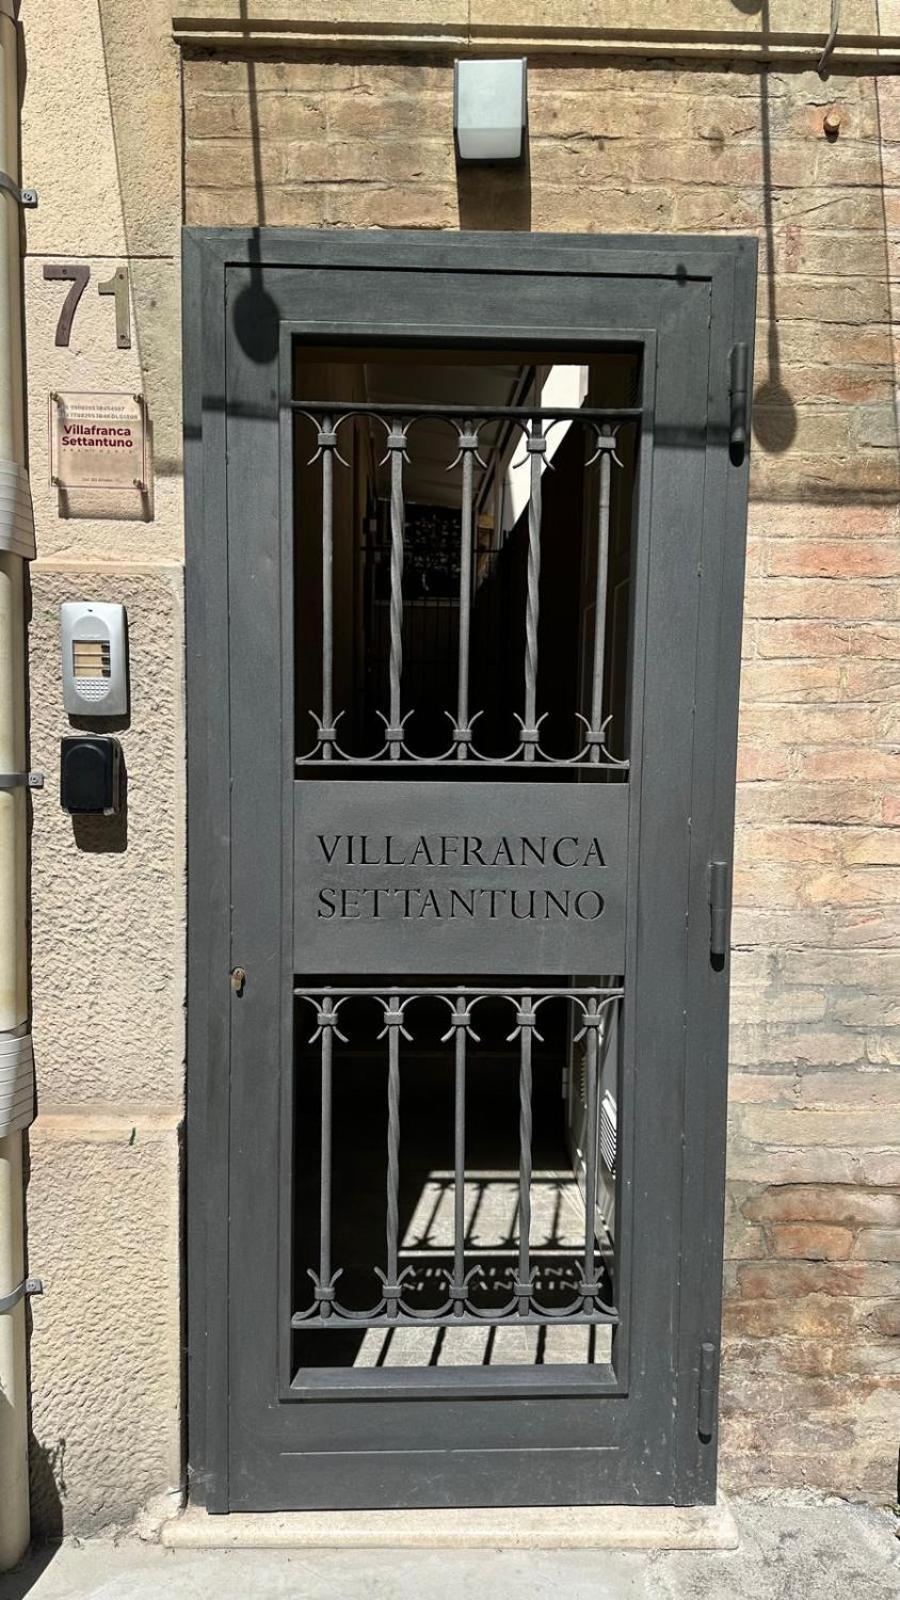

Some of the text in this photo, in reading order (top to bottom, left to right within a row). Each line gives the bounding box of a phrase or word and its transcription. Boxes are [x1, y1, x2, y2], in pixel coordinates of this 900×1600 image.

[43, 265, 131, 349] 71
[62, 436, 133, 448] Settantuno
[63, 424, 131, 436] Villafranca
[316, 835, 608, 867] VILLAFRANCA
[317, 888, 605, 919] SETTANTUNO
